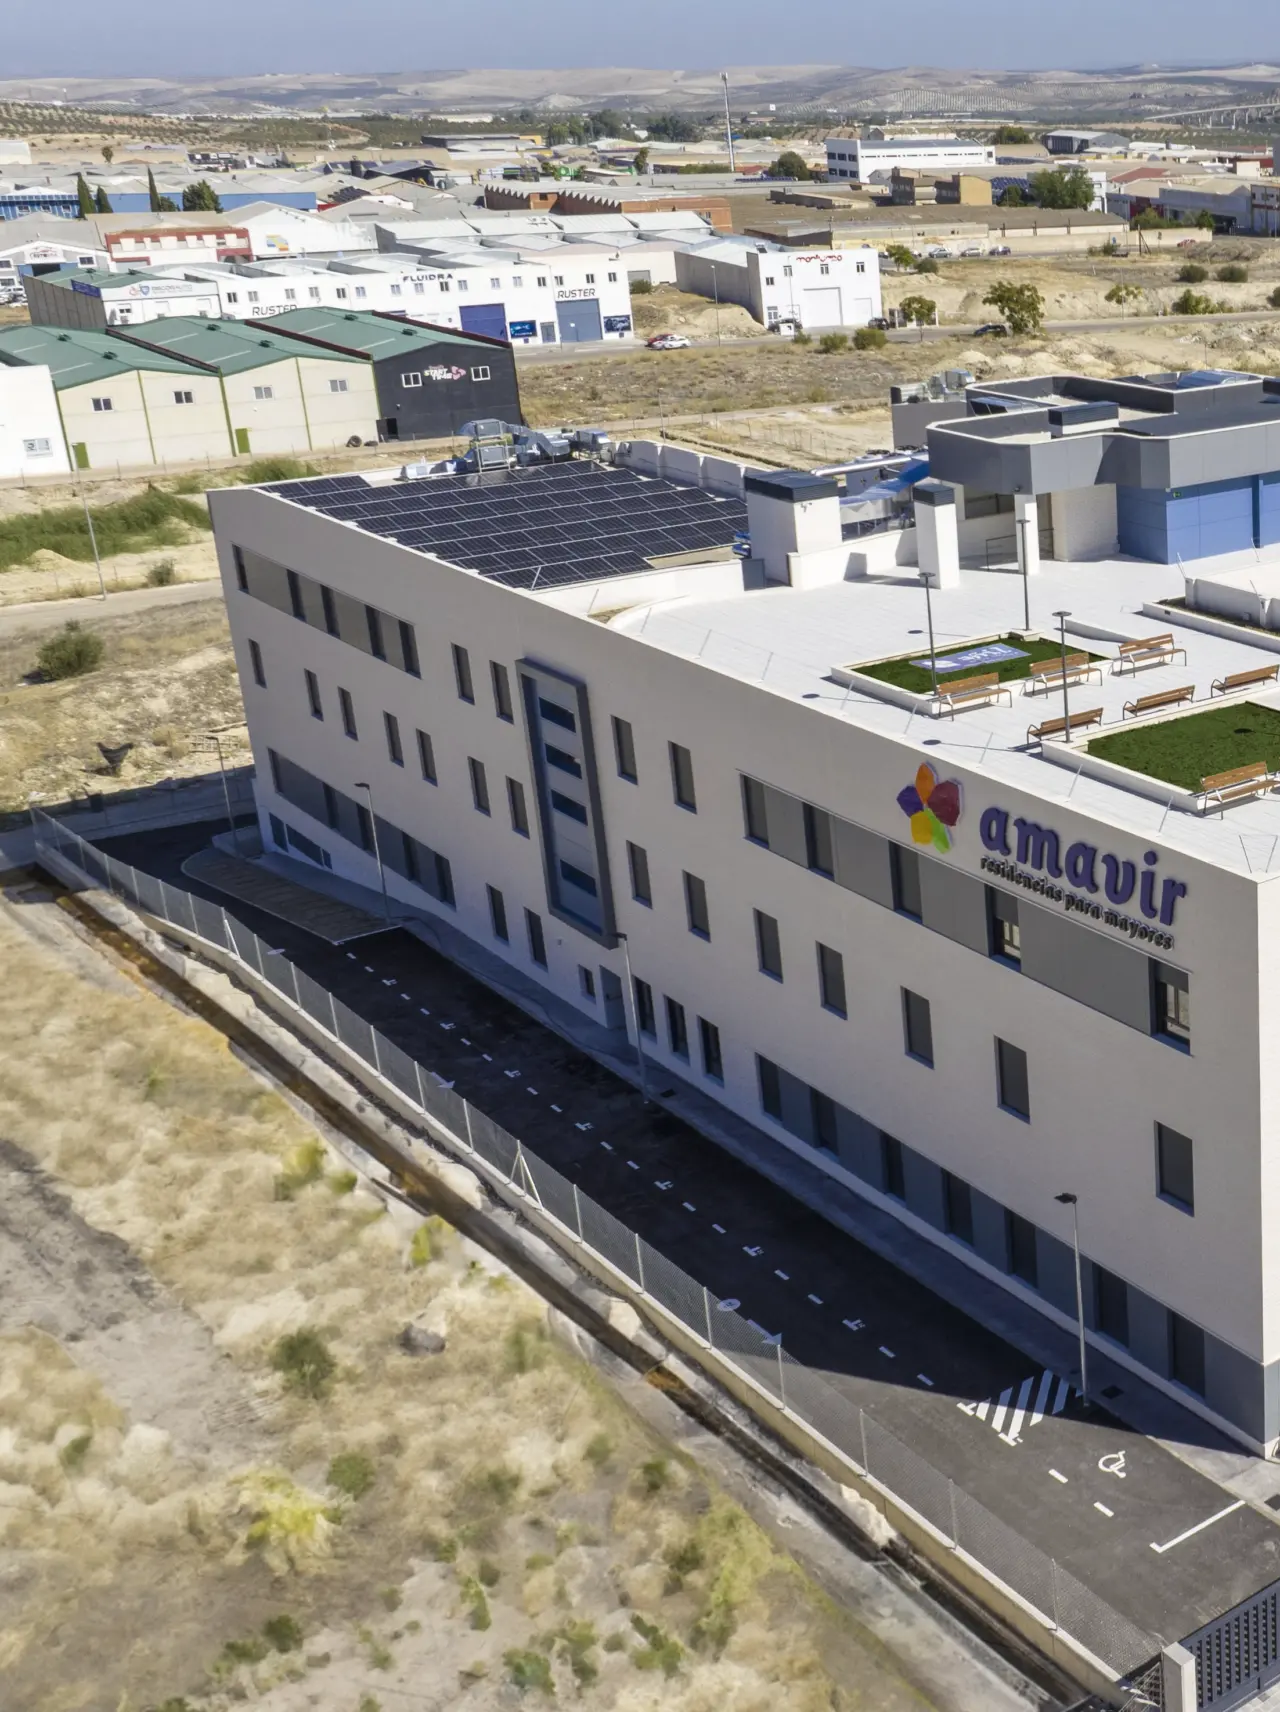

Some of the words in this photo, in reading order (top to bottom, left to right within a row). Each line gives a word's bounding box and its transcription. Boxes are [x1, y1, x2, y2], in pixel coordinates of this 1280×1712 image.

[402, 273, 453, 282] FLUIDRA
[557, 288, 596, 299] RUSTER
[980, 806, 1187, 927] amavir
[980, 854, 1064, 903] residencias
[1064, 890, 1104, 922] para
[1104, 907, 1175, 951] mayores
